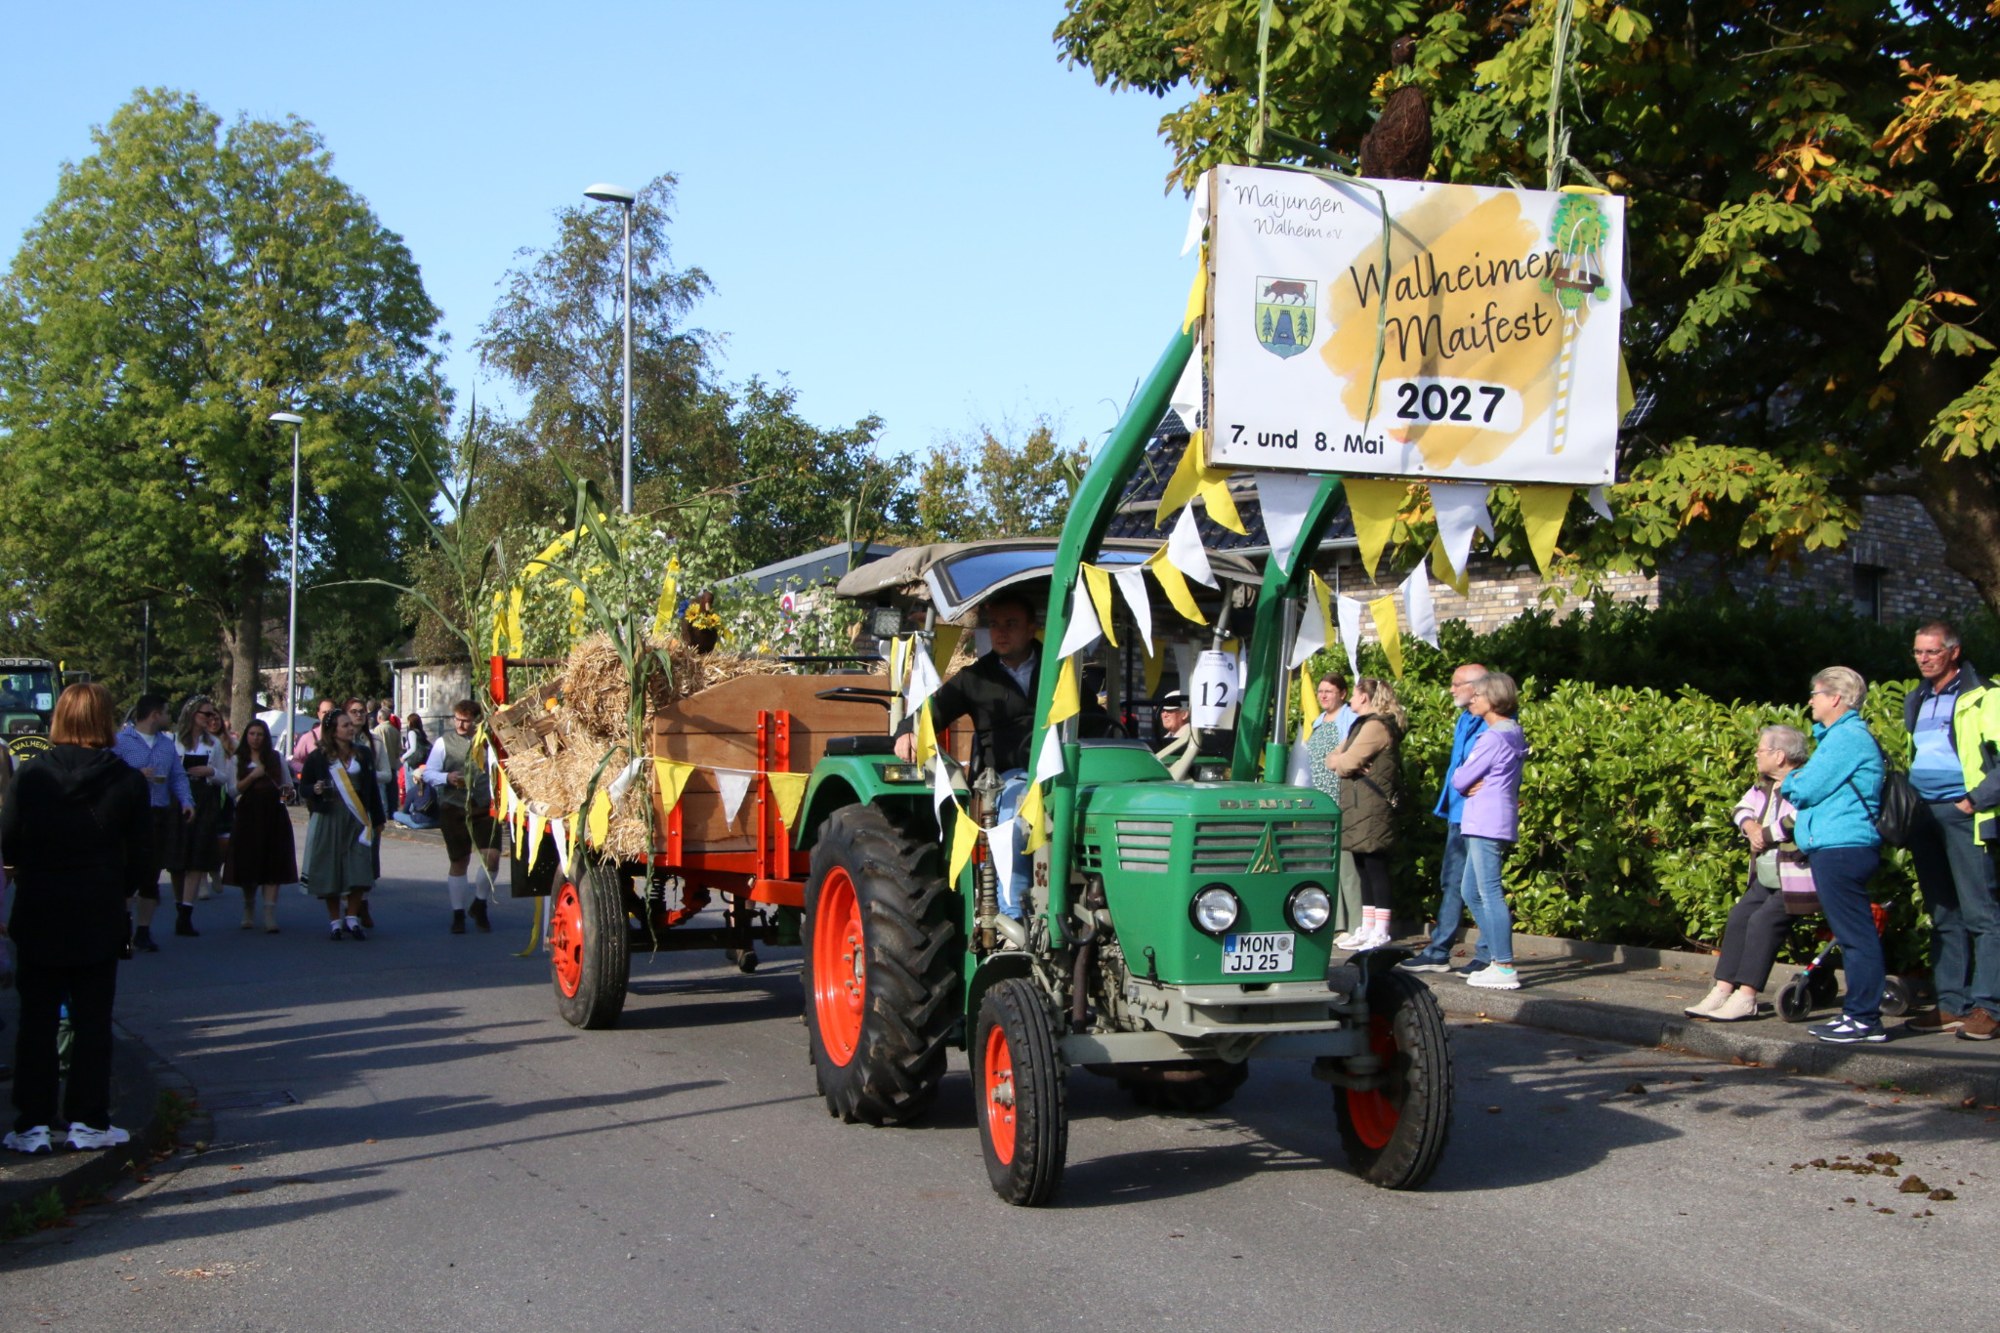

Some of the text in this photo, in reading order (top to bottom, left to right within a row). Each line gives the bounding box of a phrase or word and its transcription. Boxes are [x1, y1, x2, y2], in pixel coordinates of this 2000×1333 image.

[1234, 184, 1345, 221] Maijungen
[1254, 215, 1322, 238] Walheim
[1350, 249, 1560, 308] Walheimer
[1385, 301, 1553, 362] Maifest
[1396, 382, 1506, 423] 2027
[1231, 424, 1384, 455] 7. und 8. Mai
[1200, 681, 1229, 708] 12
[1219, 799, 1316, 810] DEUTZ
[1240, 936, 1274, 953] MON
[1231, 953, 1279, 971] JJ 25
